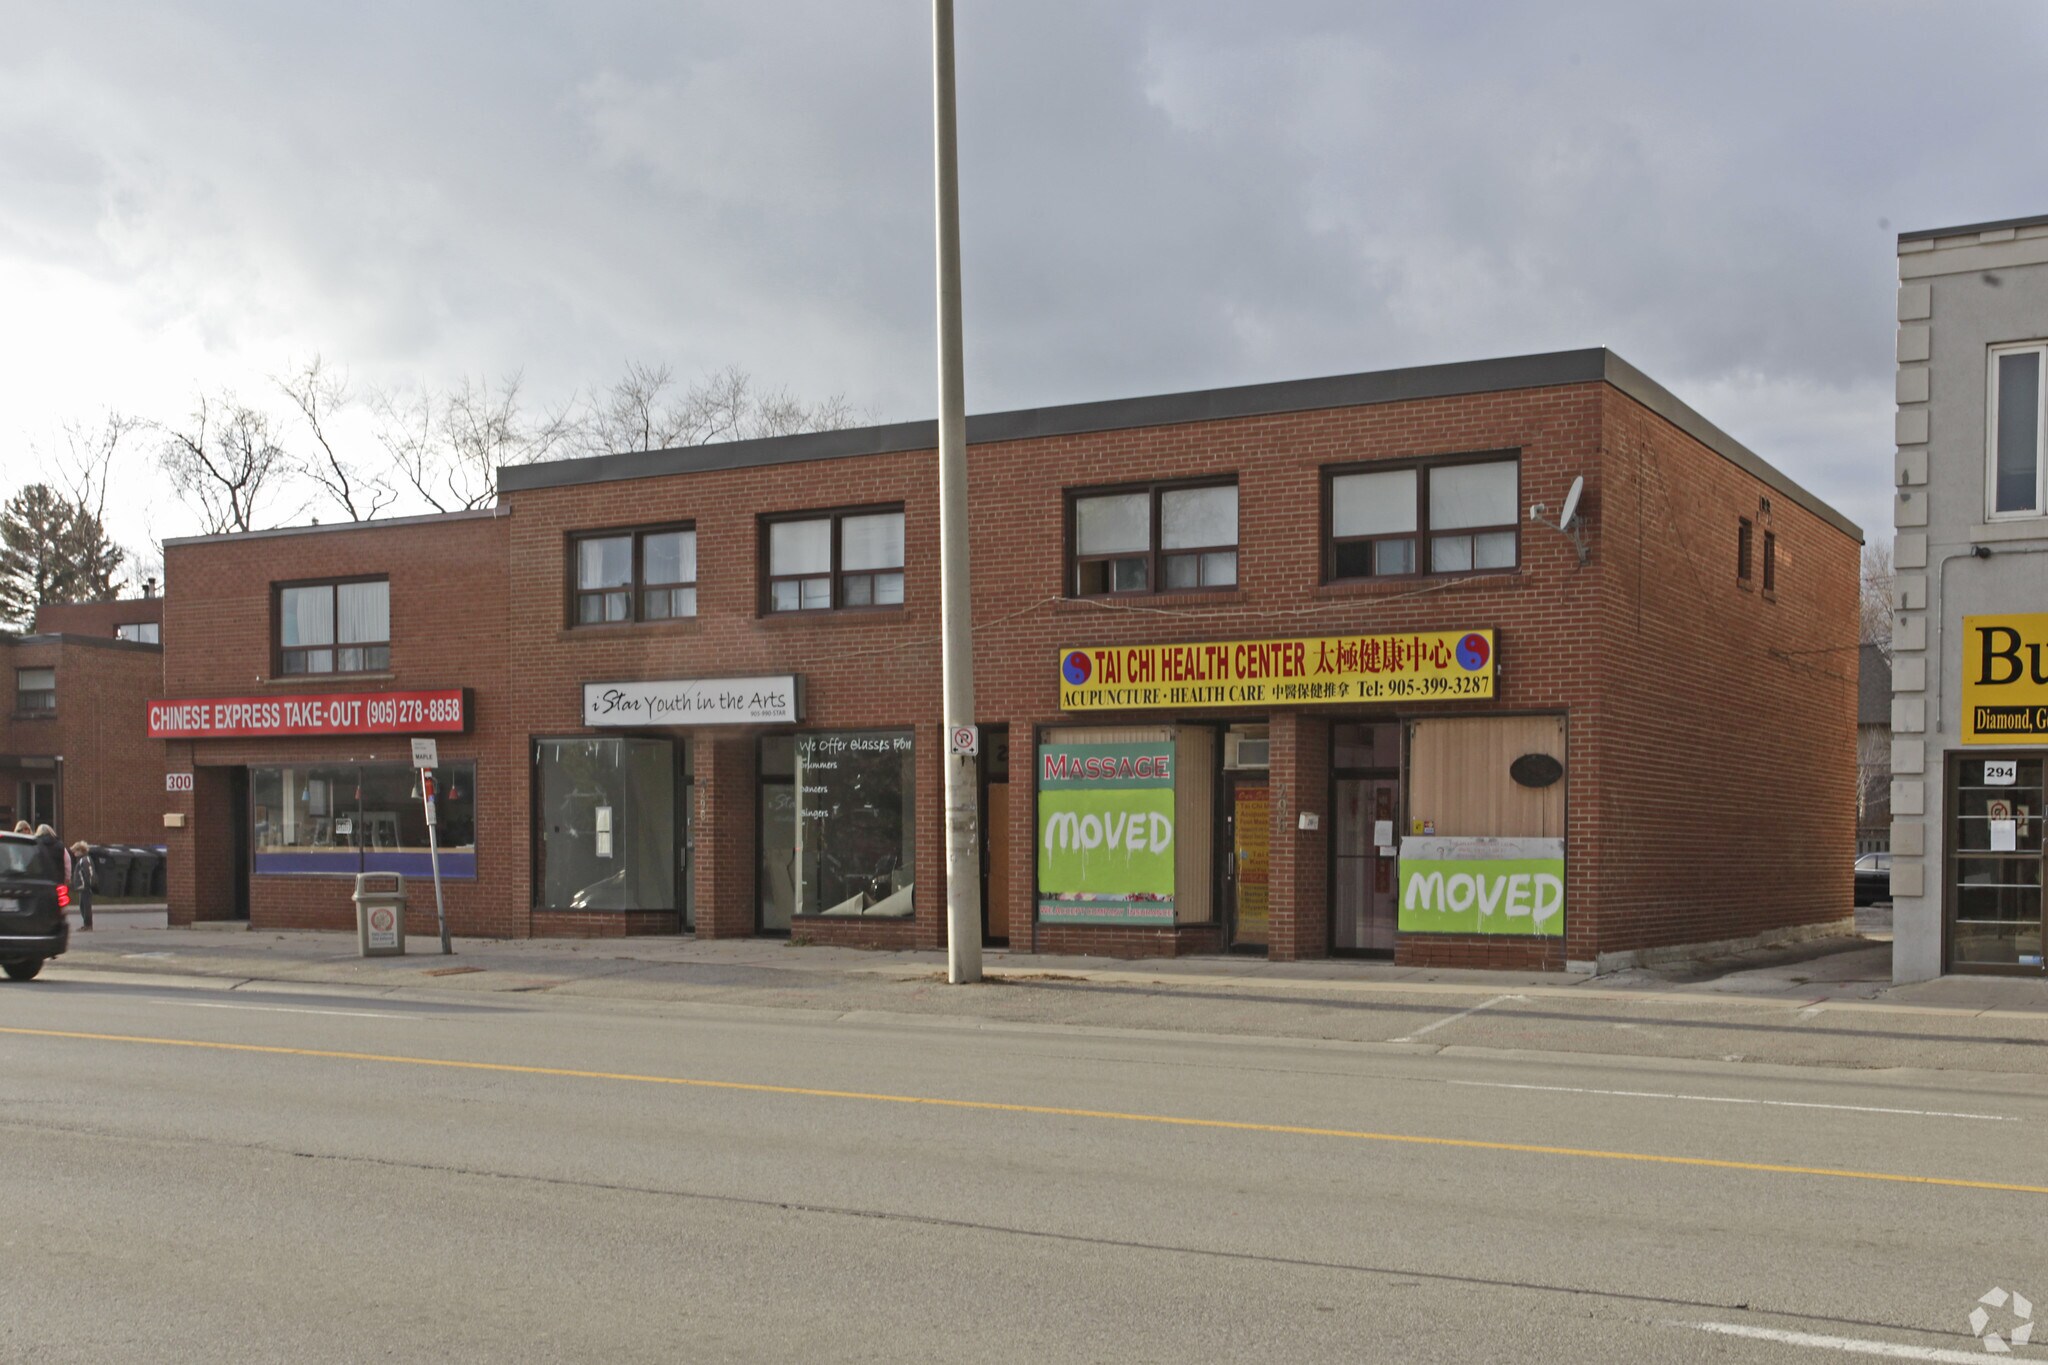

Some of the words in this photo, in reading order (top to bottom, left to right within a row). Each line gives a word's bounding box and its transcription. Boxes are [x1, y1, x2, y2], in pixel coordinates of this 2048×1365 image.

[1095, 650, 1121, 684] TAI
[1127, 648, 1156, 683] CHI
[1161, 645, 1229, 682] HEALTH
[1234, 641, 1306, 680] CENTER
[1312, 635, 1452, 676] 太極健康中心
[644, 693, 692, 719] Youth
[696, 691, 715, 711] in
[719, 691, 744, 711] the
[748, 691, 786, 710] Arts
[1062, 687, 1161, 707] ACUPUNCTURE
[1169, 685, 1225, 704] HEALTH
[1229, 684, 1266, 702] CARE
[1272, 681, 1350, 700] 中醫保健推拿
[1357, 679, 1384, 698] Tel:
[1388, 675, 1489, 697] 905-399-3287
[150, 704, 210, 731] CHINESE
[215, 702, 280, 729] EXPRESS
[284, 701, 361, 727] TAKE-OUT
[366, 698, 397, 728] (905)
[399, 698, 460, 724] 278-8858
[1976, 707, 2033, 733] Diamond,
[2036, 707, 2048, 730] G
[818, 737, 848, 755] Offer
[1043, 754, 1170, 780] MASSAGE
[1986, 767, 2014, 778] 294
[167, 775, 192, 790] 300
[1044, 811, 1172, 855] MOVED
[1404, 871, 1564, 922] MOVED
